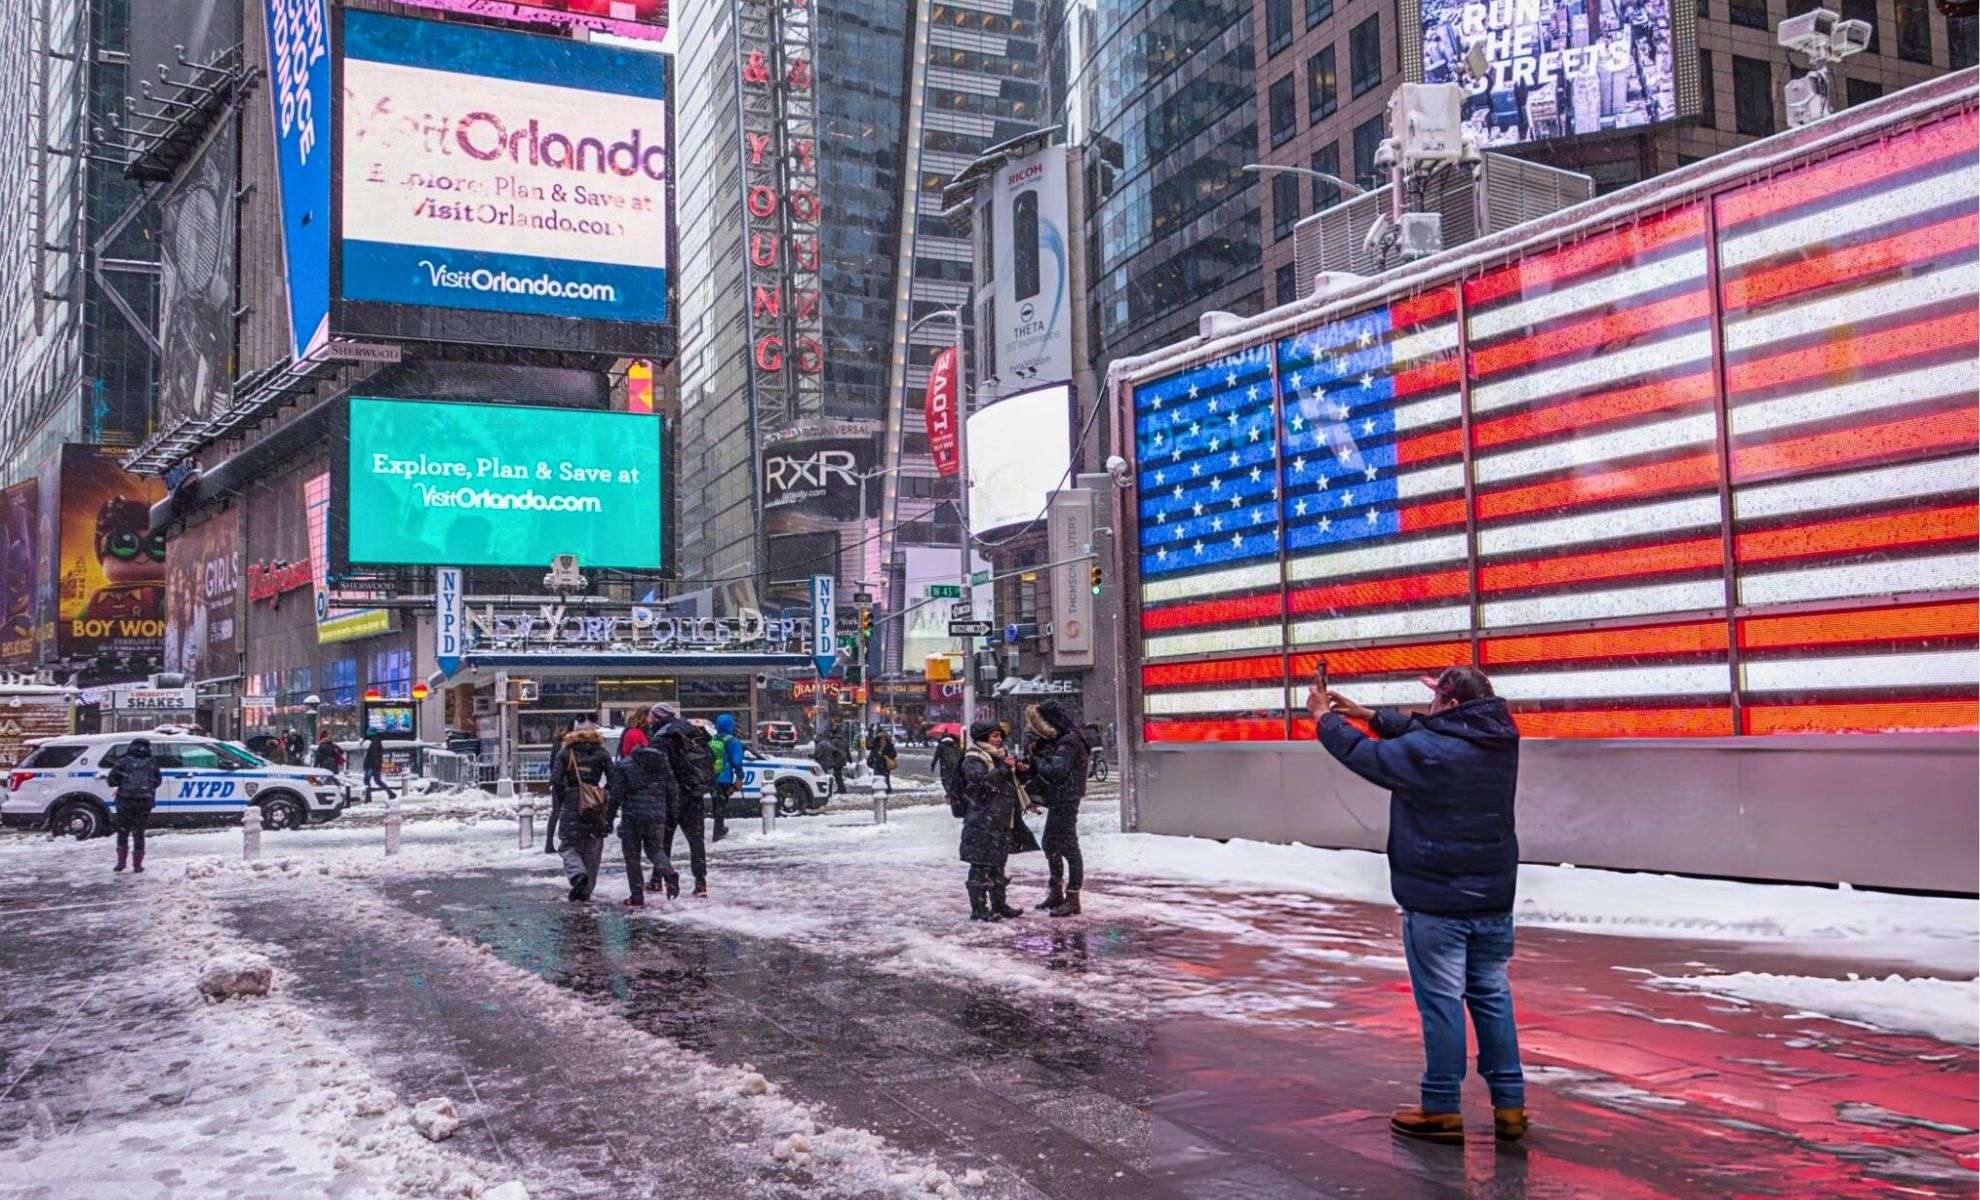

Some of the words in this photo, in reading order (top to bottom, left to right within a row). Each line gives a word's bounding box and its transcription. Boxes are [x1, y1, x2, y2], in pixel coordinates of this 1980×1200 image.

[1461, 0, 1542, 37] RUN
[743, 51, 769, 83] &
[1008, 163, 1042, 185] RICOH
[494, 176, 545, 202] Plan
[551, 183, 567, 204] &
[573, 185, 625, 208] Save
[747, 132, 783, 372] YOUNG
[418, 260, 617, 302] VisitOrlando.com
[1014, 320, 1045, 339] THETA
[331, 343, 399, 360] SHERWOOD
[372, 453, 472, 480] Explore,
[477, 457, 529, 480] Plan
[535, 461, 552, 481] &
[559, 461, 612, 484] Save
[618, 466, 640, 484] at
[766, 450, 857, 494] RXR
[412, 482, 602, 513] VisitOrlando.com
[1067, 515, 1078, 558] UTERS
[205, 551, 239, 598] GIRLS
[339, 580, 395, 591] SHERWOOD
[73, 619, 114, 638] BOY
[443, 572, 456, 653] NYPD
[540, 604, 618, 642] YORK
[819, 578, 832, 653] NYPD
[973, 625, 986, 633] WAY
[127, 697, 185, 708] SHAKES
[178, 780, 236, 799] NYPD
